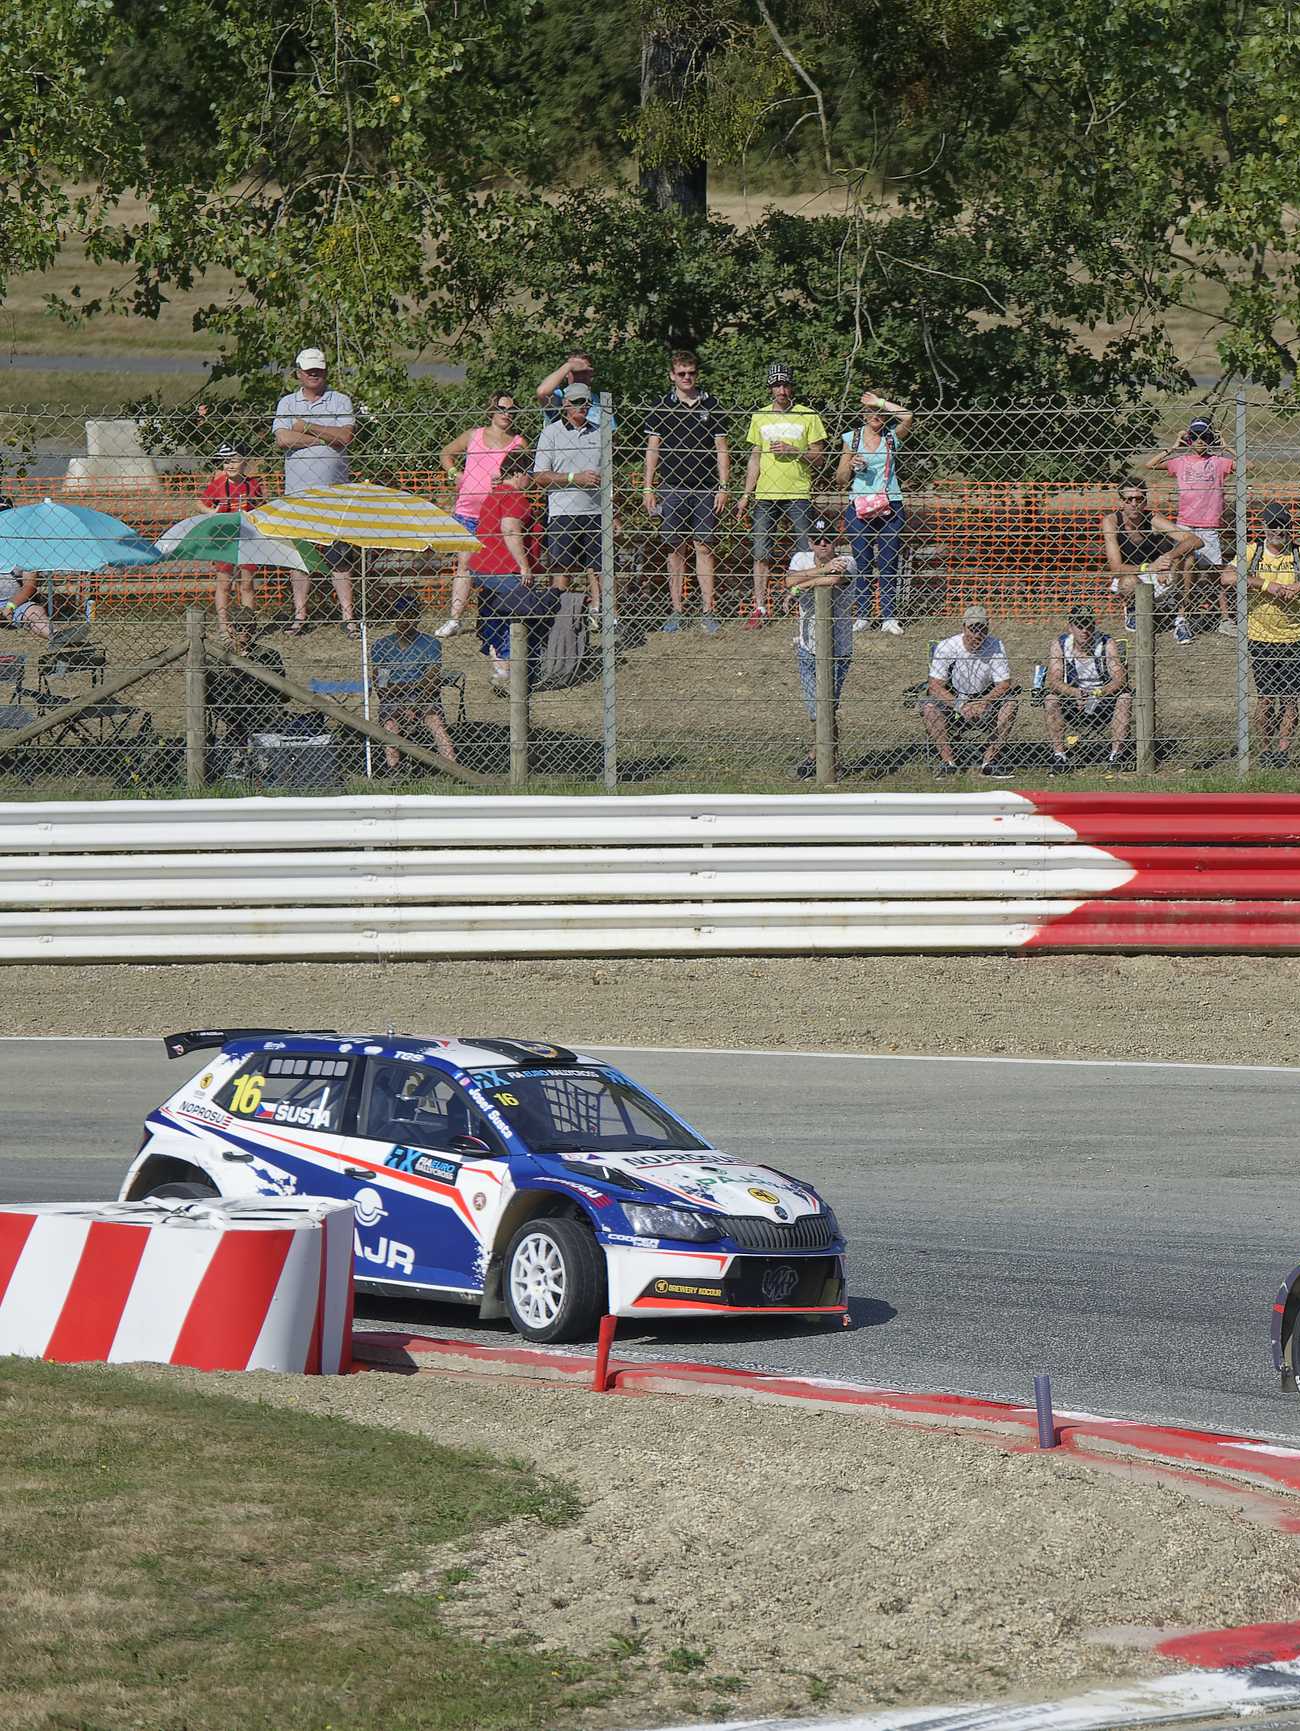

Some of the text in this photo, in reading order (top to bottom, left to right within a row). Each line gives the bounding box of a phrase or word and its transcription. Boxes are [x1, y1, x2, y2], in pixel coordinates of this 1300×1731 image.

[228, 1074, 265, 1114] 16
[493, 1093, 520, 1106] 16
[180, 1101, 224, 1125] NOPROSU
[274, 1101, 330, 1129] ŠUSTA
[418, 1157, 456, 1173] FIA EURO
[668, 1284, 698, 1295] BREWERY
